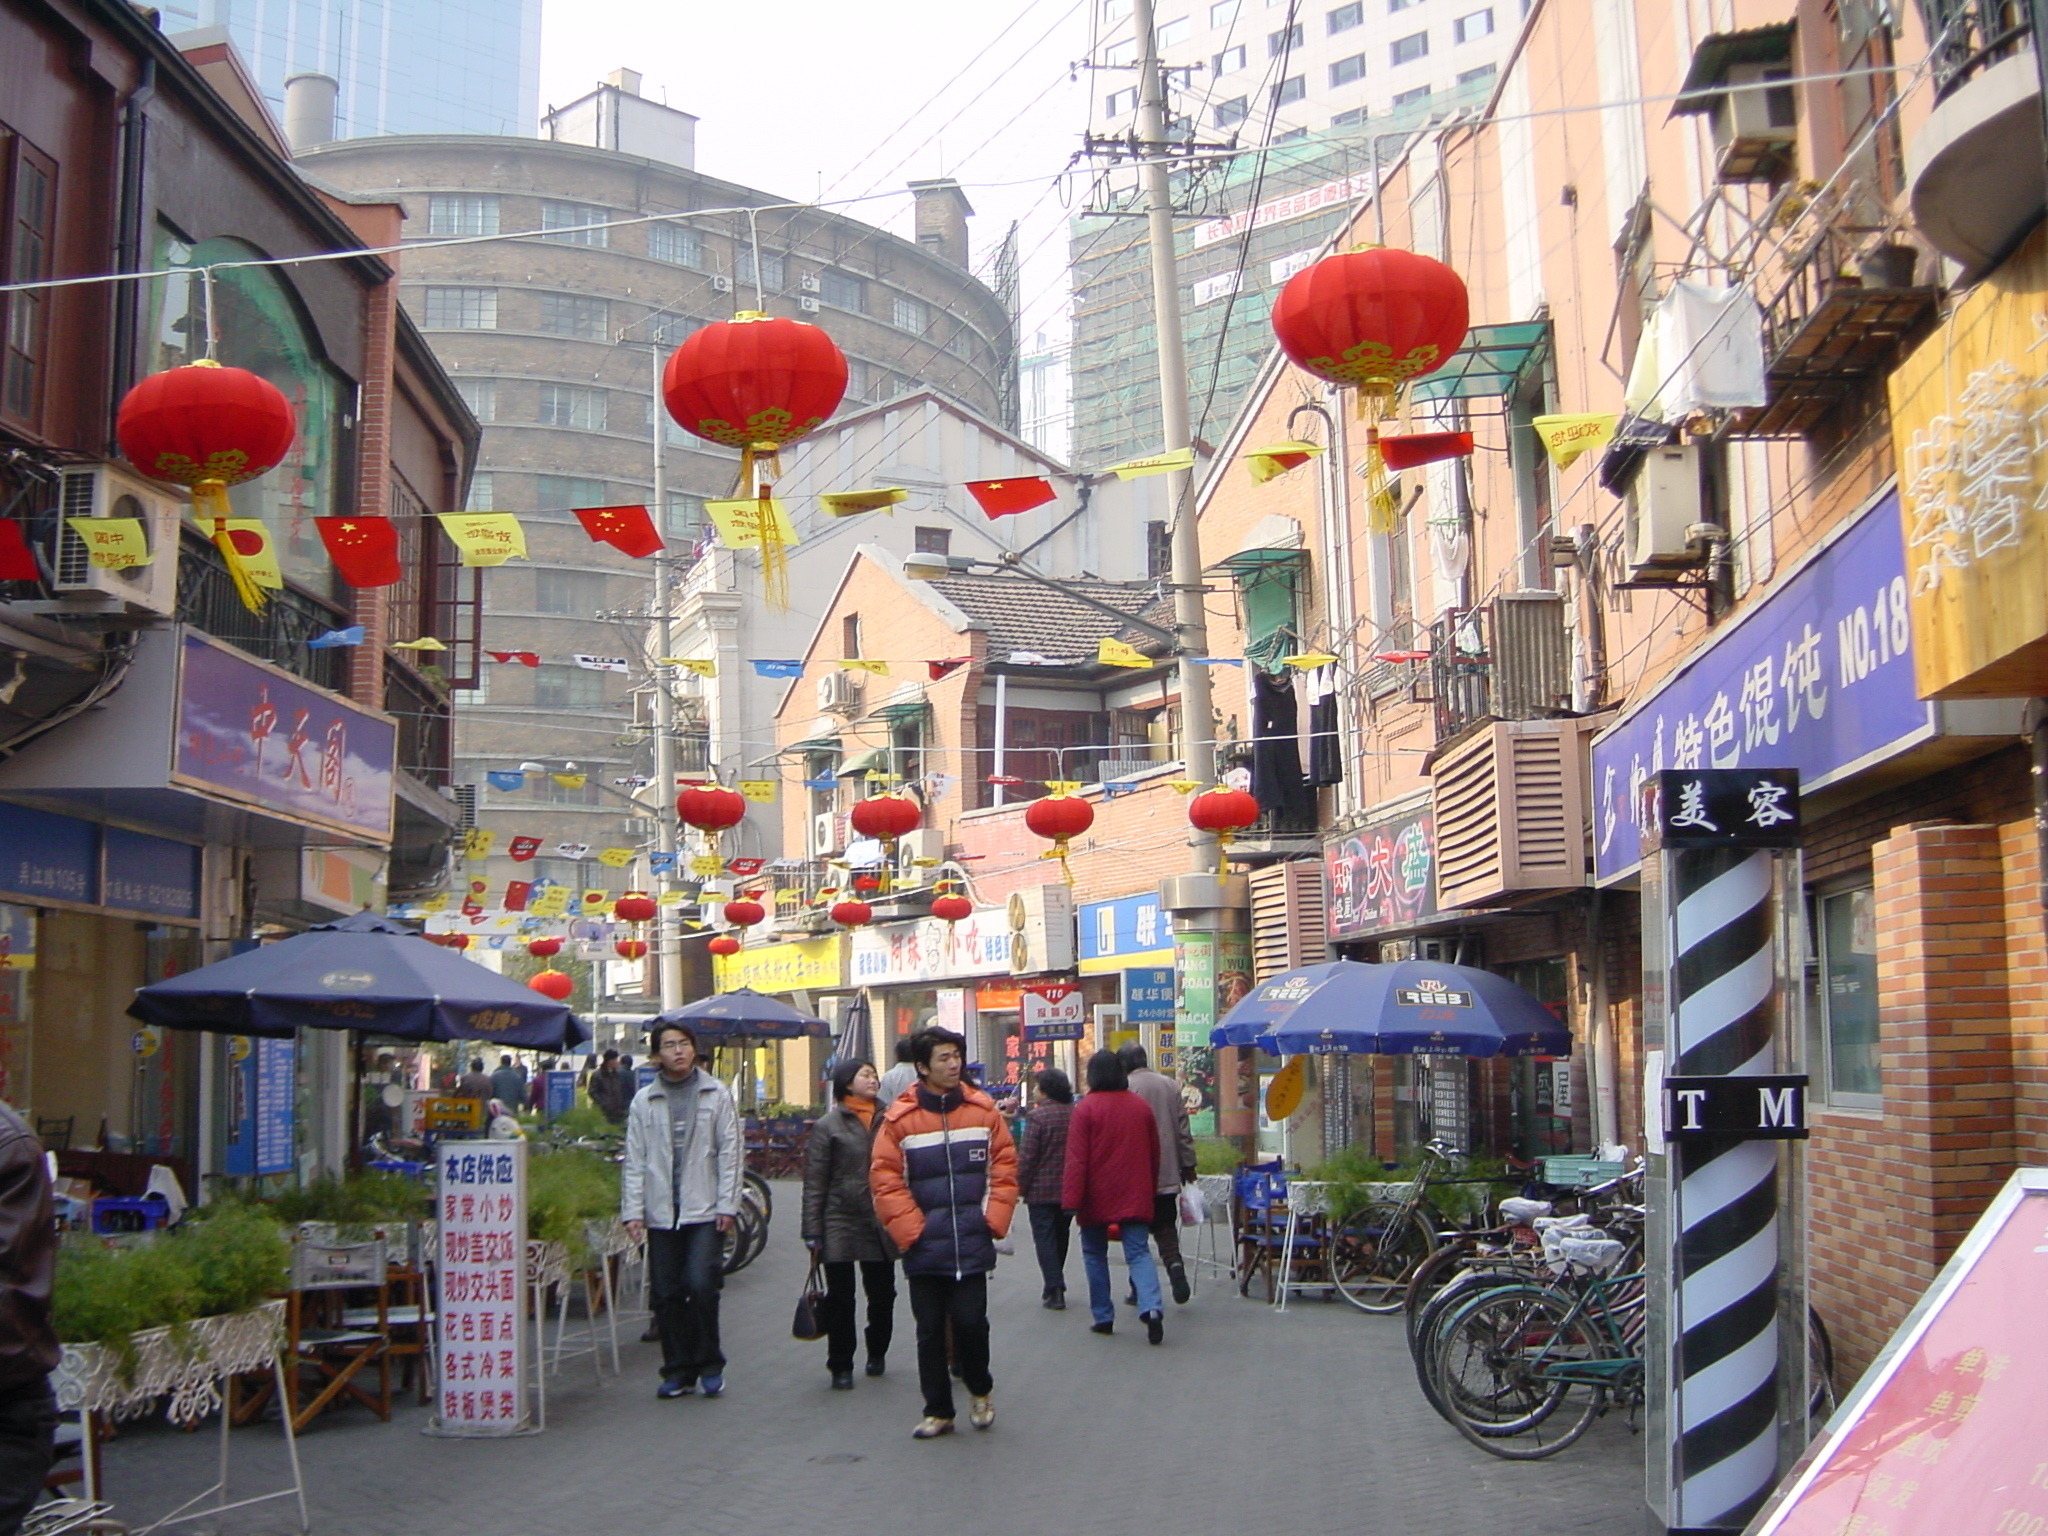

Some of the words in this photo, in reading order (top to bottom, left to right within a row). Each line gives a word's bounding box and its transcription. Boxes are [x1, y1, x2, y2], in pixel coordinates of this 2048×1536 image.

[1838, 575, 1909, 689] NO.18
[1670, 780, 1793, 832] 美容
[1226, 959, 1245, 969] WU
[1045, 989, 1063, 999] 110
[1677, 1090, 1705, 1129] T
[1758, 1088, 1795, 1127] M
[445, 1154, 514, 1185] 本店供应
[445, 1193, 514, 1223] 家常小炒
[445, 1312, 514, 1342] 花色面点
[445, 1351, 514, 1380] 各式冷菜
